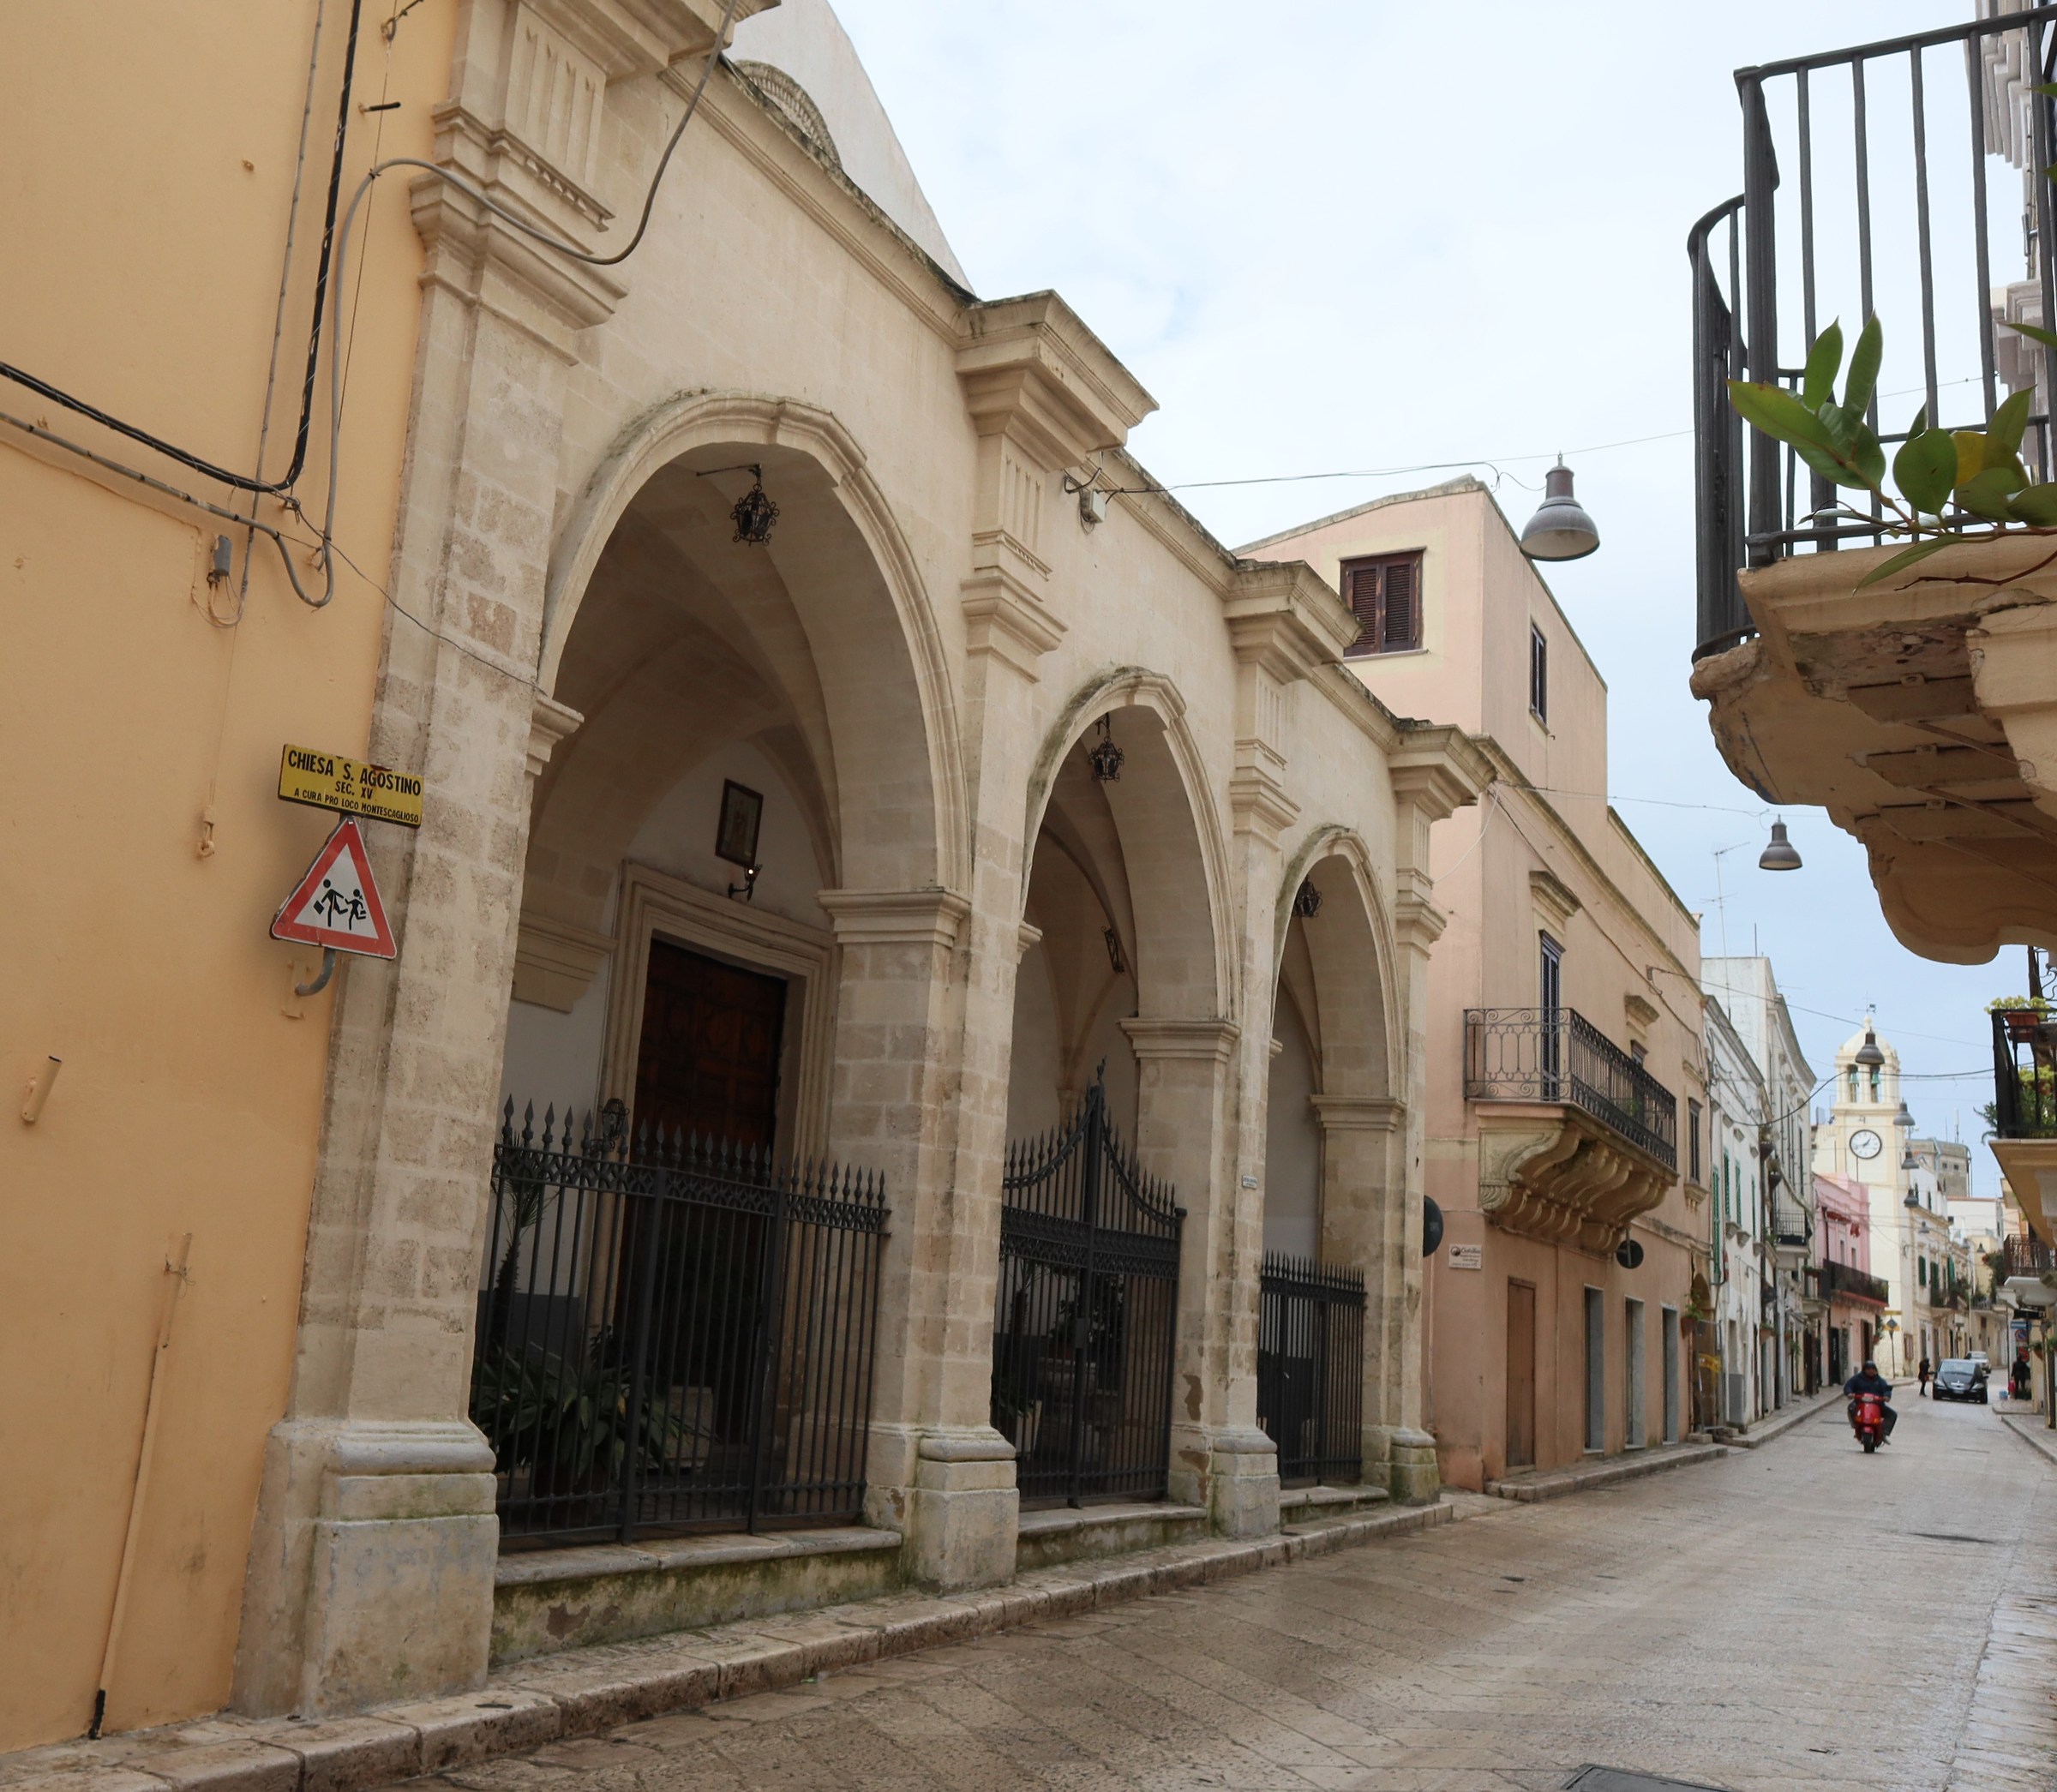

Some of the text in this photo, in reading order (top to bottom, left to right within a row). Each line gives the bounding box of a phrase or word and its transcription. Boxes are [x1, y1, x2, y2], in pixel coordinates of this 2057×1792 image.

[289, 750, 421, 796] CHIESA S. AGOSTINO
[335, 781, 373, 800] SEC. XV
[294, 788, 419, 823] A CURA PRO LOCO MONTESCAGLIOSO
